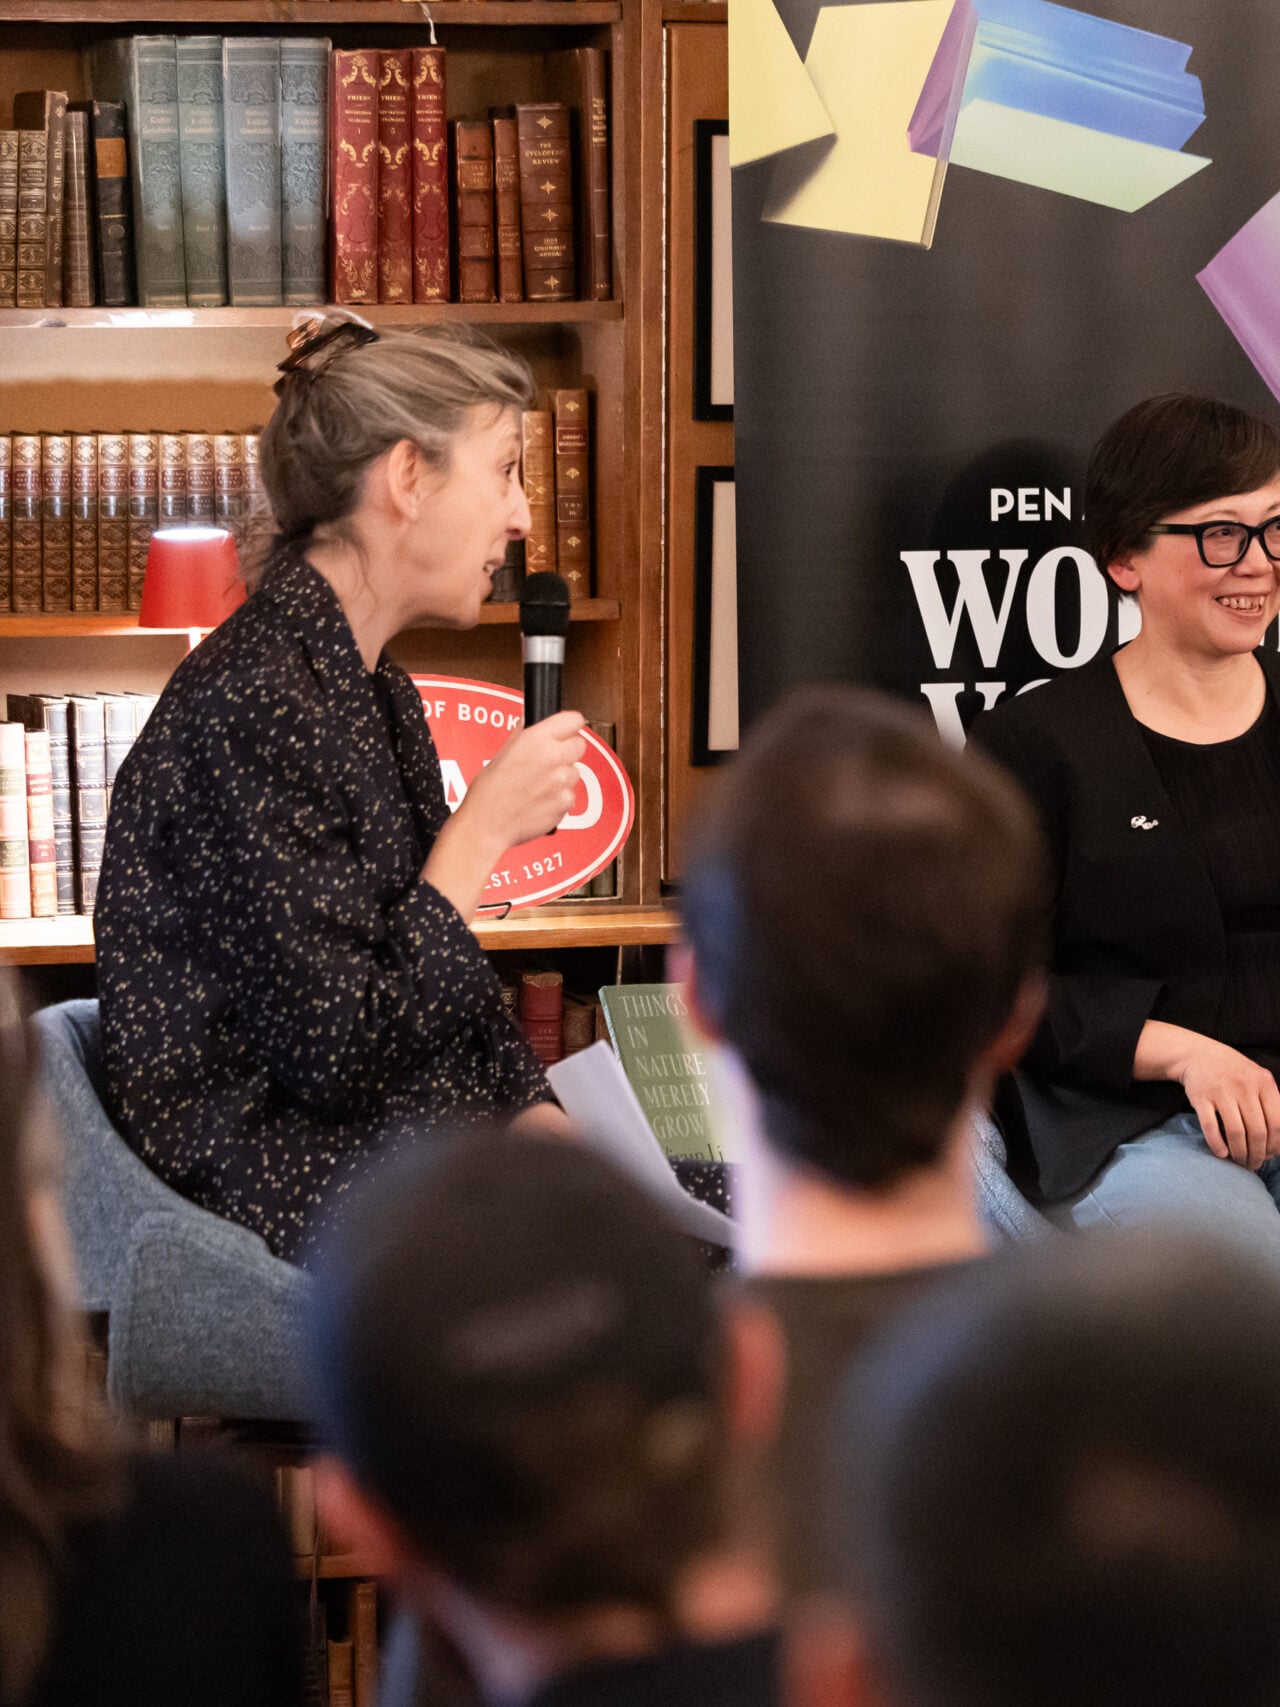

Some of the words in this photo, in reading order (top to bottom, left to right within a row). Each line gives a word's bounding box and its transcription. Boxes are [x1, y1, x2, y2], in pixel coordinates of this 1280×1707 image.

[990, 488, 1070, 521] PEN
[458, 703, 521, 731] BOOK
[522, 851, 564, 880] 1927
[618, 994, 688, 1018] THINGS
[628, 1024, 649, 1048] IN
[635, 1053, 706, 1078] NATURE
[642, 1083, 711, 1108] MERELY
[652, 1113, 705, 1139] GROW
